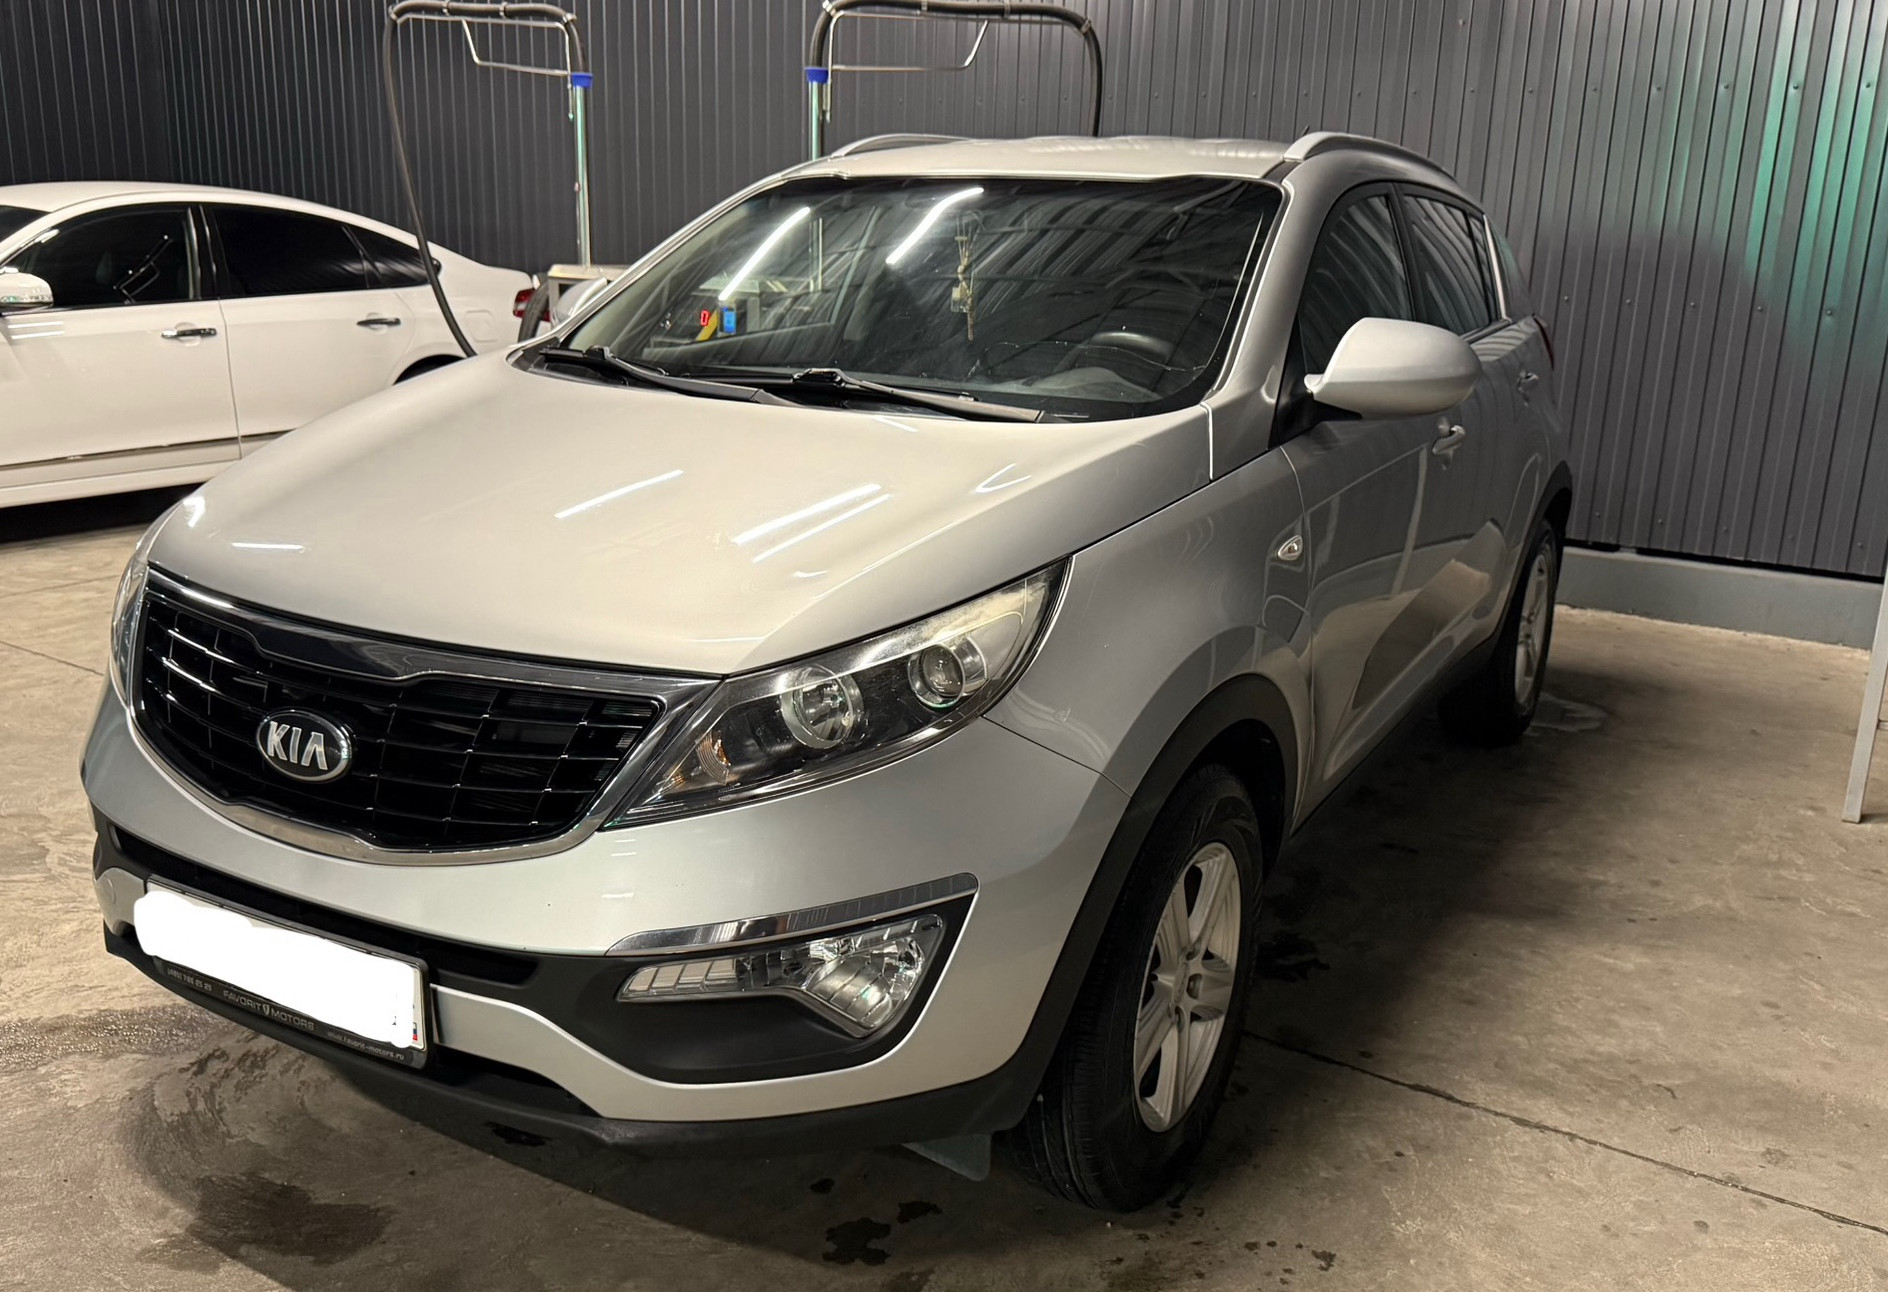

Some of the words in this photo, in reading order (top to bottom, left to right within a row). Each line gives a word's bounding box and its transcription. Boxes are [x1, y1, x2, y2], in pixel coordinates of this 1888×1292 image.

[267, 720, 328, 771] KIA
[223, 990, 262, 1011] FAVORIT
[270, 1008, 315, 1031] MOTORS
[327, 1031, 405, 1060] .favorit-motors.ru
